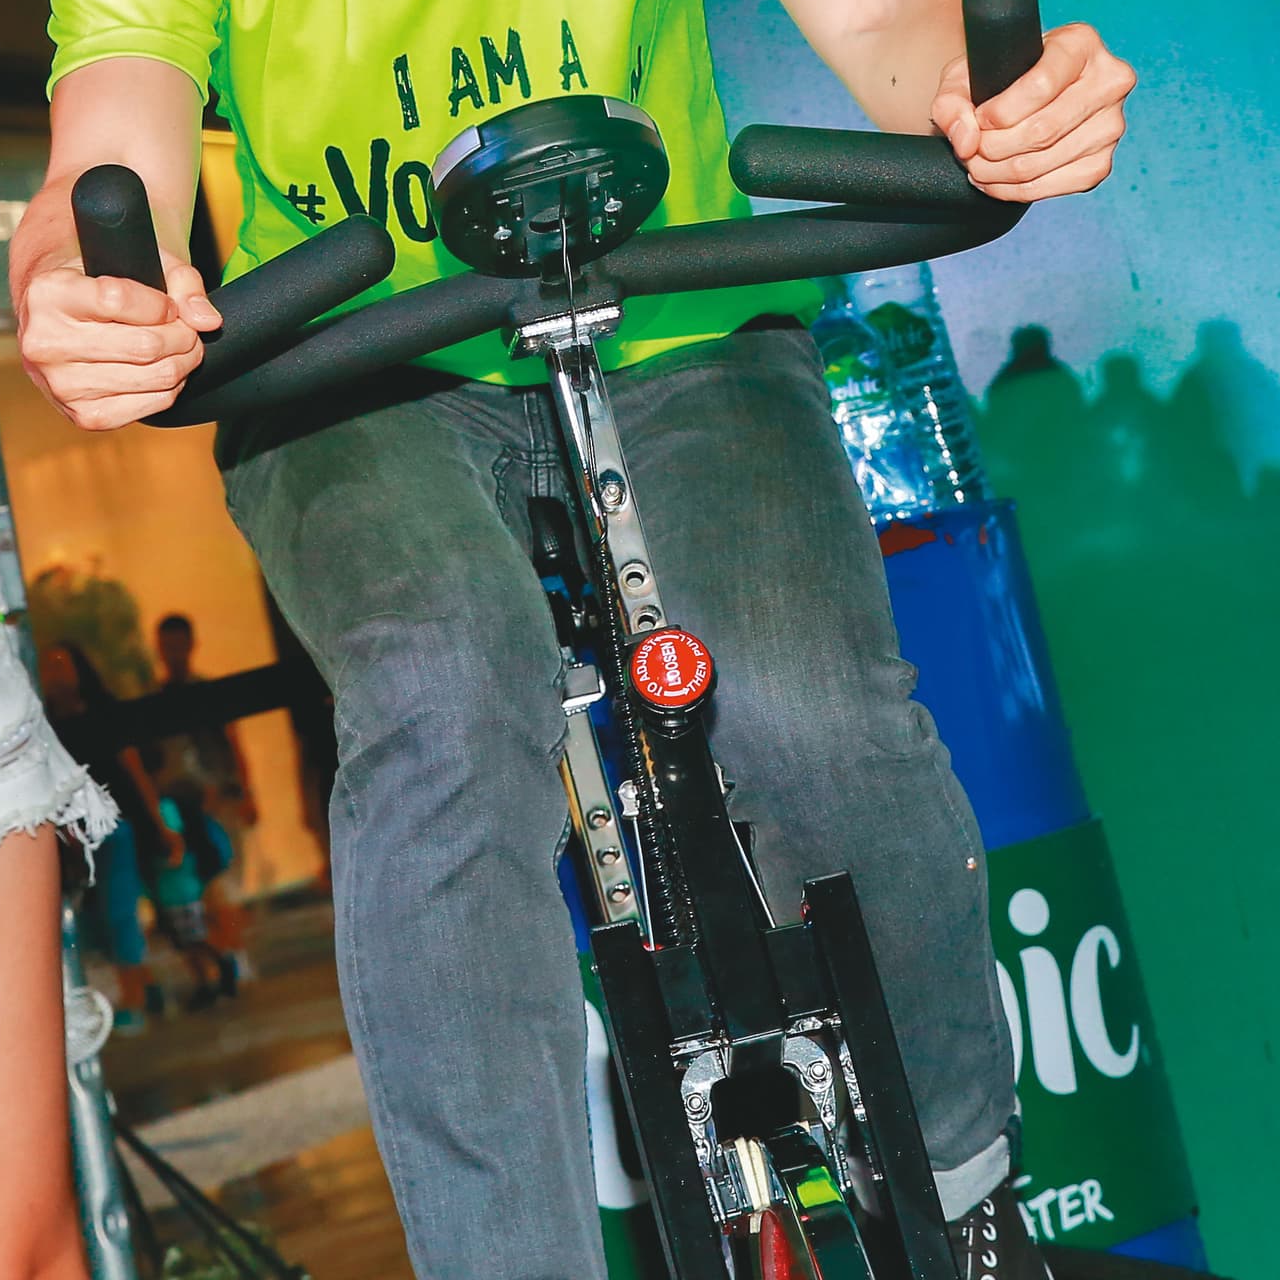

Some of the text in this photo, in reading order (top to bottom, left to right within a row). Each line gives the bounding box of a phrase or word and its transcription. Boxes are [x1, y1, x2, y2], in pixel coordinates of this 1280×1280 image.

[392, 53, 418, 130] I
[447, 26, 532, 117] AM
[559, 19, 588, 91] A
[636, 639, 665, 697] TO ADJUST
[659, 641, 682, 687] LOOSEN
[678, 633, 707, 693] THEN PULL
